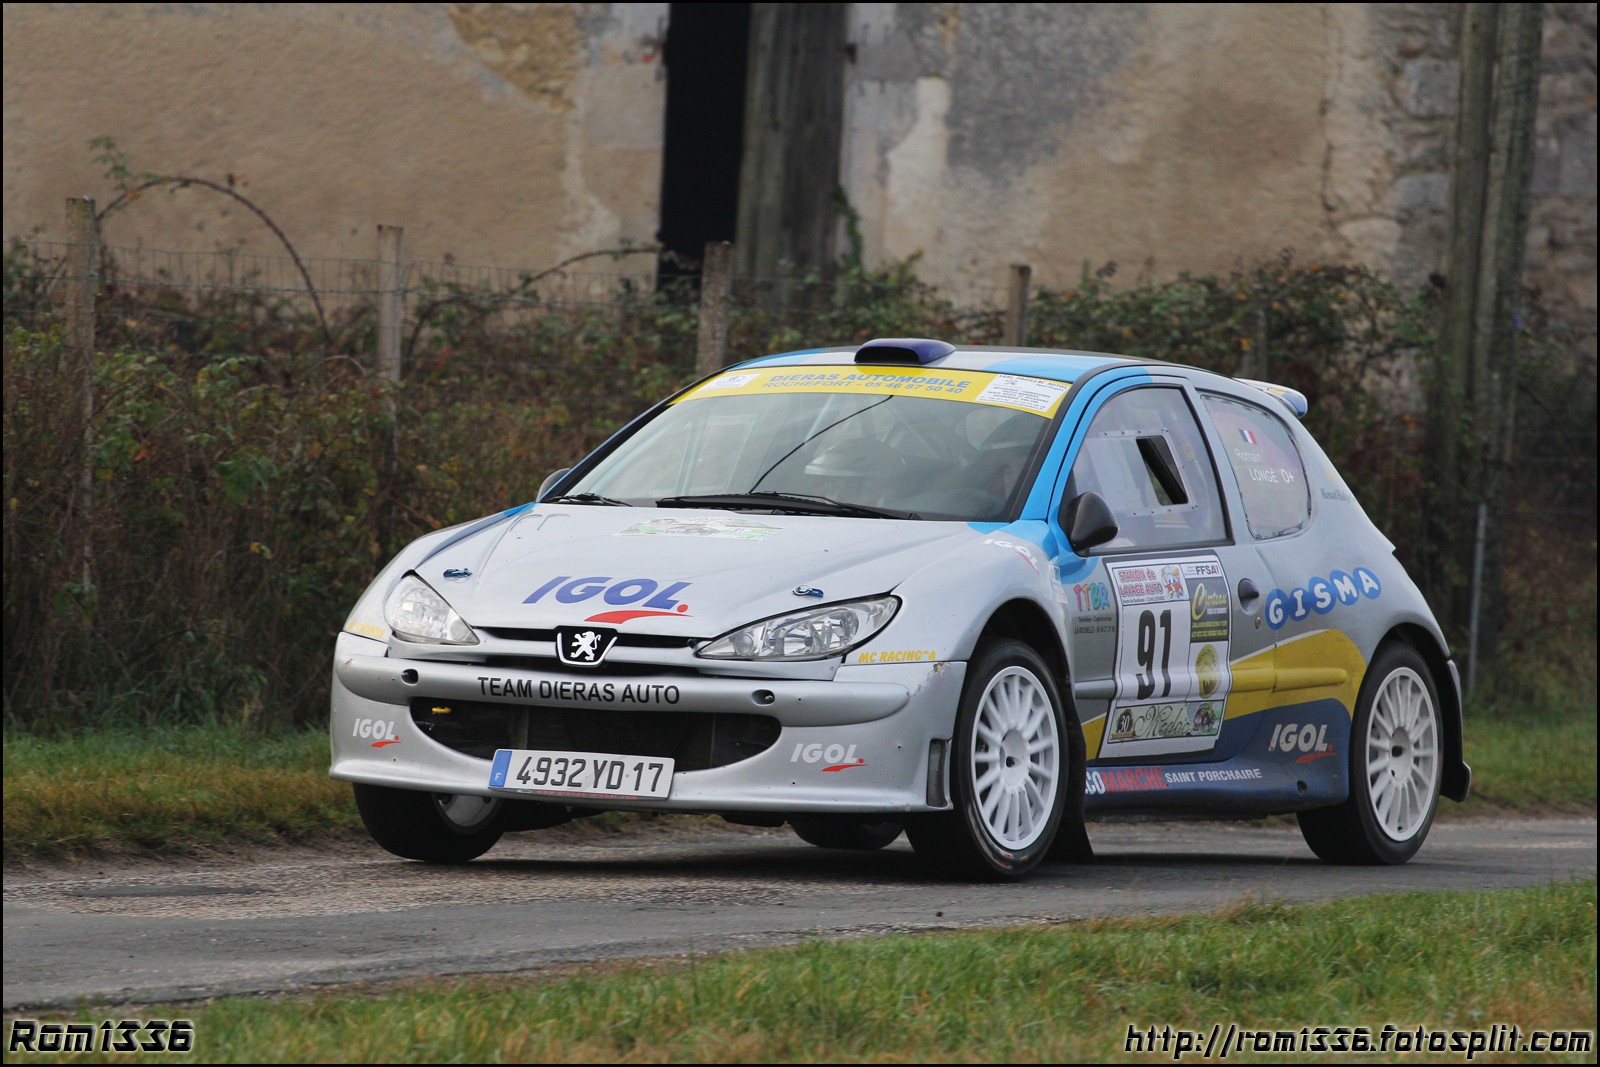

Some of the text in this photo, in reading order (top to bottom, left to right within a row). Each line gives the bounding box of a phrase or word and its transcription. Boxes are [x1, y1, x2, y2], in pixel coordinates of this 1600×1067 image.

[769, 373, 972, 389] DIERAS AUTOMOBILE
[1233, 448, 1264, 463] Romain
[1118, 567, 1156, 582] STATION de
[1195, 565, 1217, 575] FFSA
[1073, 582, 1111, 612] TTBR
[1119, 582, 1164, 598] LAVAGE AUTO
[1268, 570, 1379, 624] GISMA
[858, 651, 877, 663] MC
[1136, 609, 1172, 700] 91
[477, 676, 680, 704] TEAM DIERAS AUTO
[1120, 715, 1130, 732] 30
[494, 772, 502, 781] F
[516, 756, 664, 792] 4932 YD 17
[1164, 772, 1196, 783] SAINT
[1198, 768, 1263, 782] PORCHAIRE
